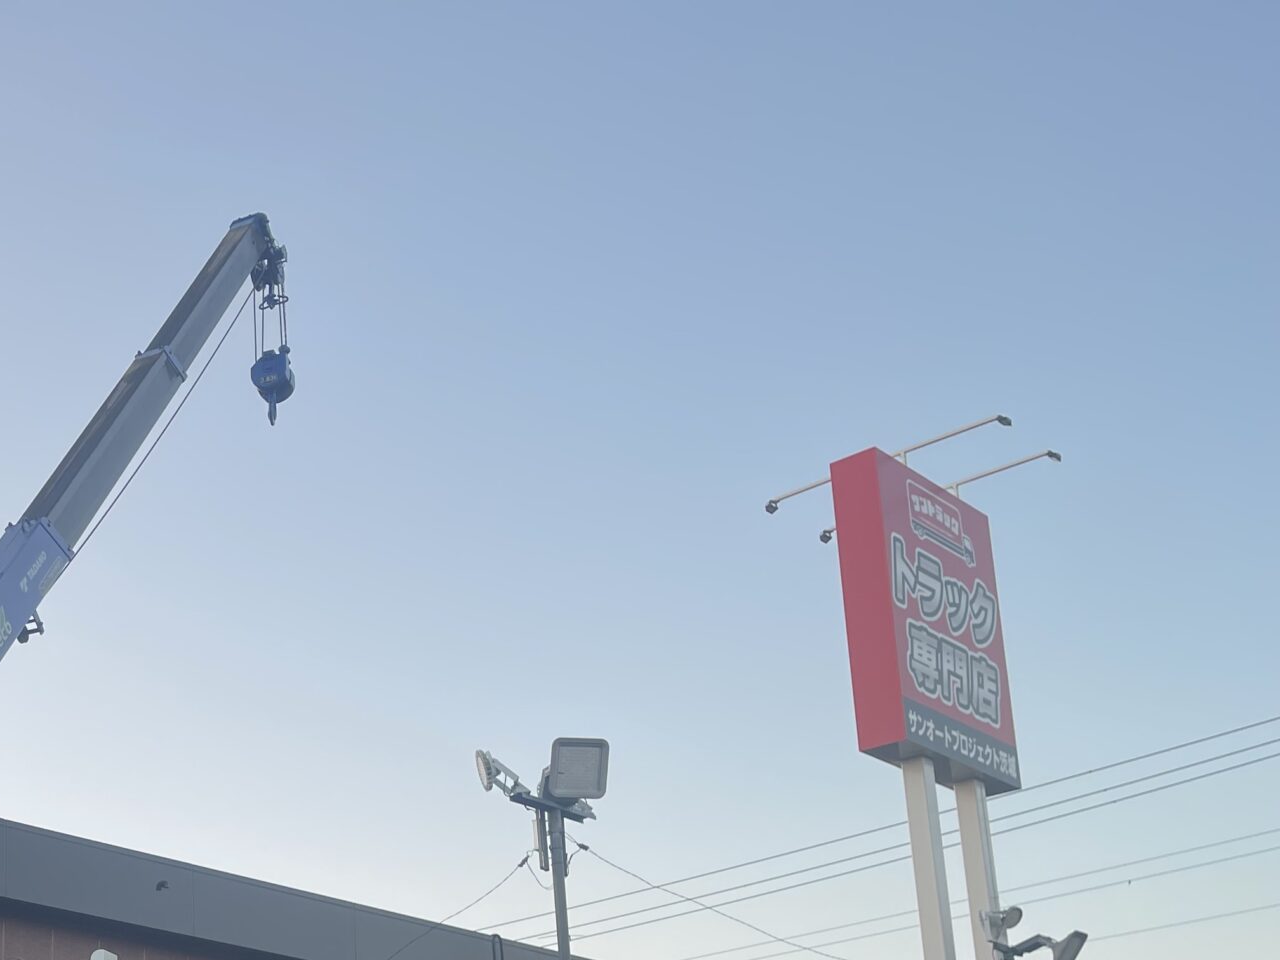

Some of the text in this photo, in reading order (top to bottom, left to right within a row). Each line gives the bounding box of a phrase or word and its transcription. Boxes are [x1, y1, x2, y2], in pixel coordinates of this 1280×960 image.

[891, 532, 997, 648] トラック
[905, 618, 1000, 729] 専門店
